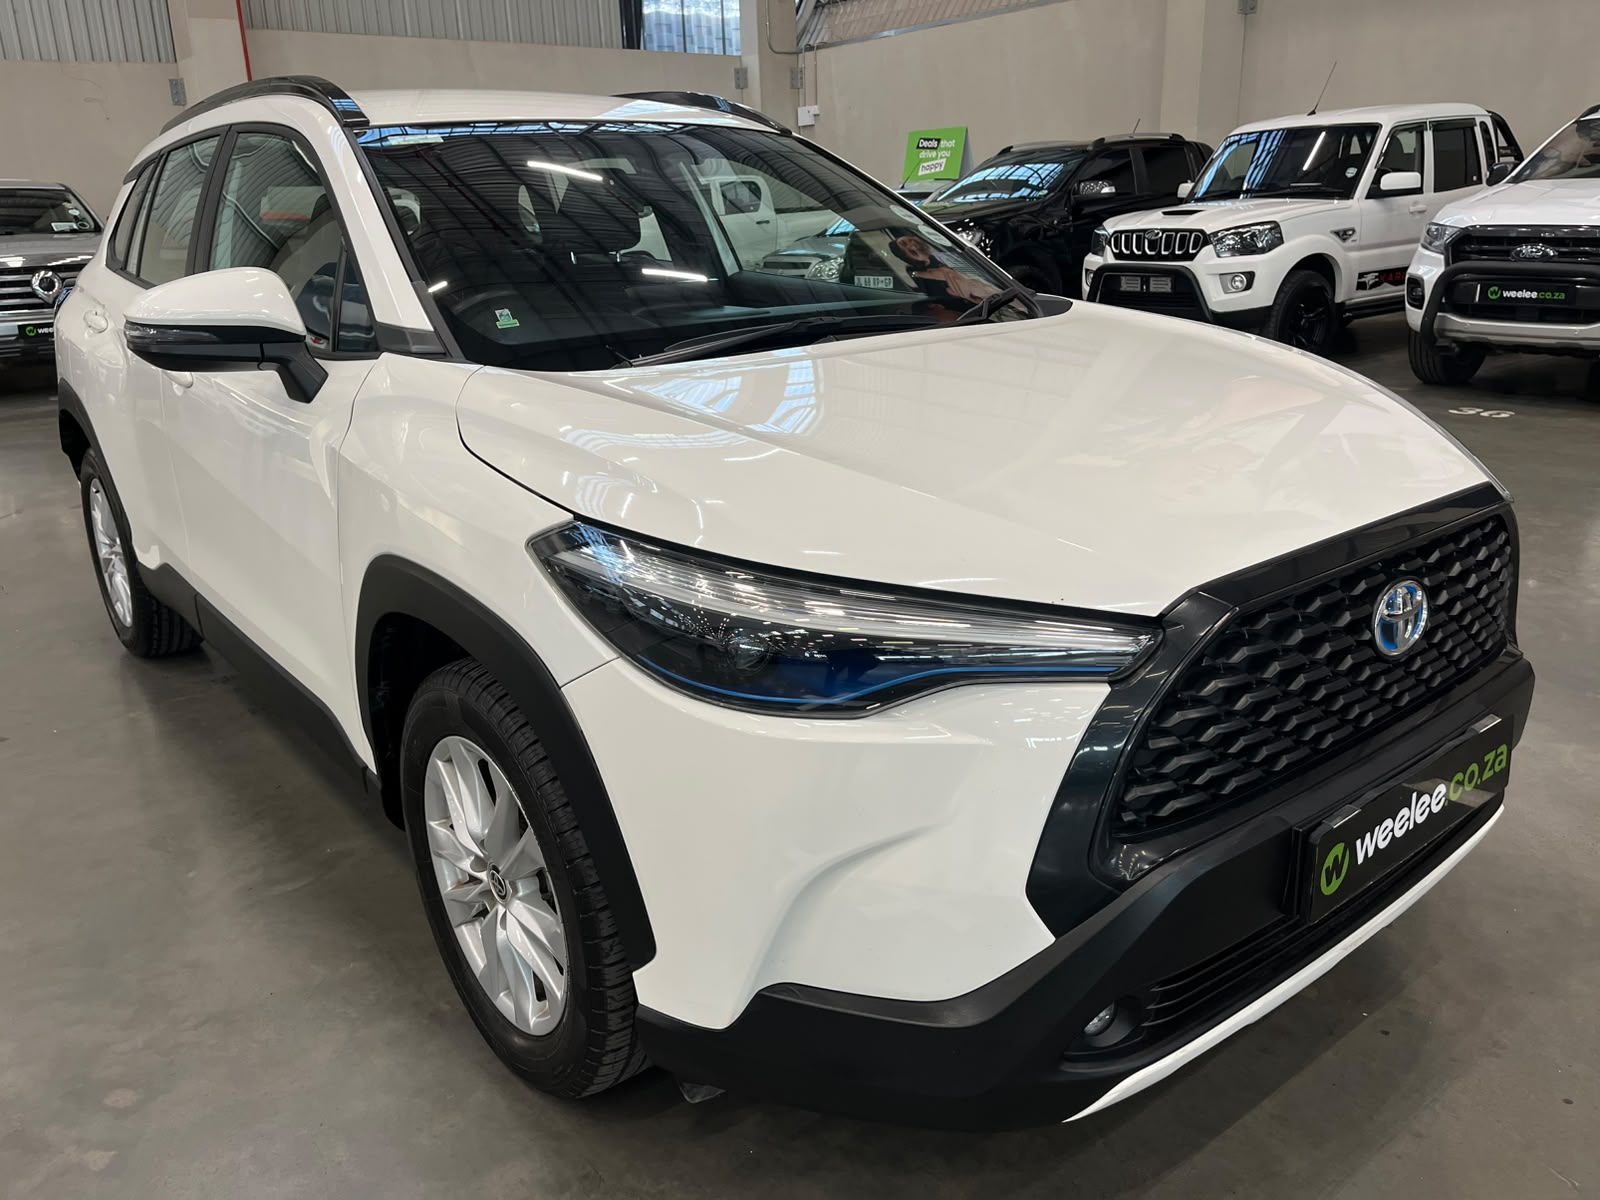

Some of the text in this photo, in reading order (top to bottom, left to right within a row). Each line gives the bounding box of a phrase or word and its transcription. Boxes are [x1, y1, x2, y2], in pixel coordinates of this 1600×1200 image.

[919, 139, 956, 149] Deals that
[919, 150, 952, 161] drive you
[920, 161, 944, 174] happy
[1502, 288, 1566, 300] weelee.co.za
[1355, 743, 1508, 865] weelee.co.za
